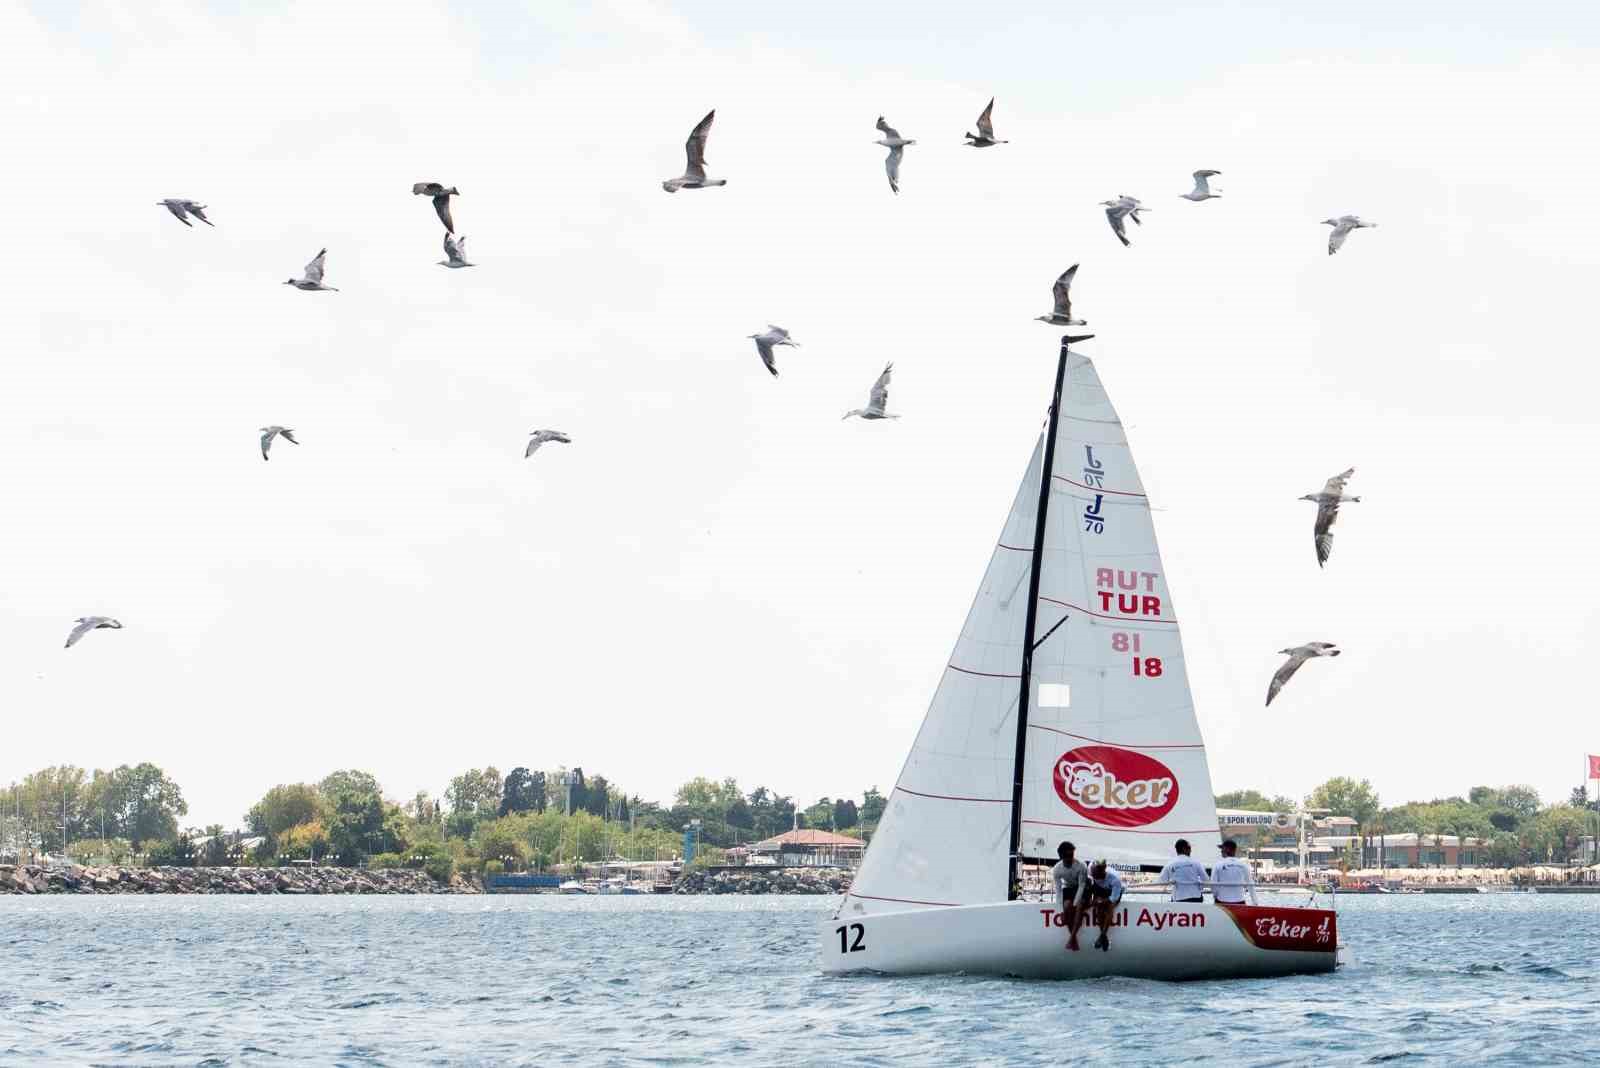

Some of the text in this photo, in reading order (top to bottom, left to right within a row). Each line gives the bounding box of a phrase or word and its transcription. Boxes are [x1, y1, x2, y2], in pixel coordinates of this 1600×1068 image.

[1086, 494, 1104, 515] J
[1085, 520, 1104, 535] 70
[1098, 591, 1161, 615] TUR
[1132, 656, 1162, 678] 18
[1080, 775, 1170, 806] eker
[1227, 816, 1245, 825] SPOR
[1136, 908, 1205, 931] Ayran
[836, 923, 866, 954] 12
